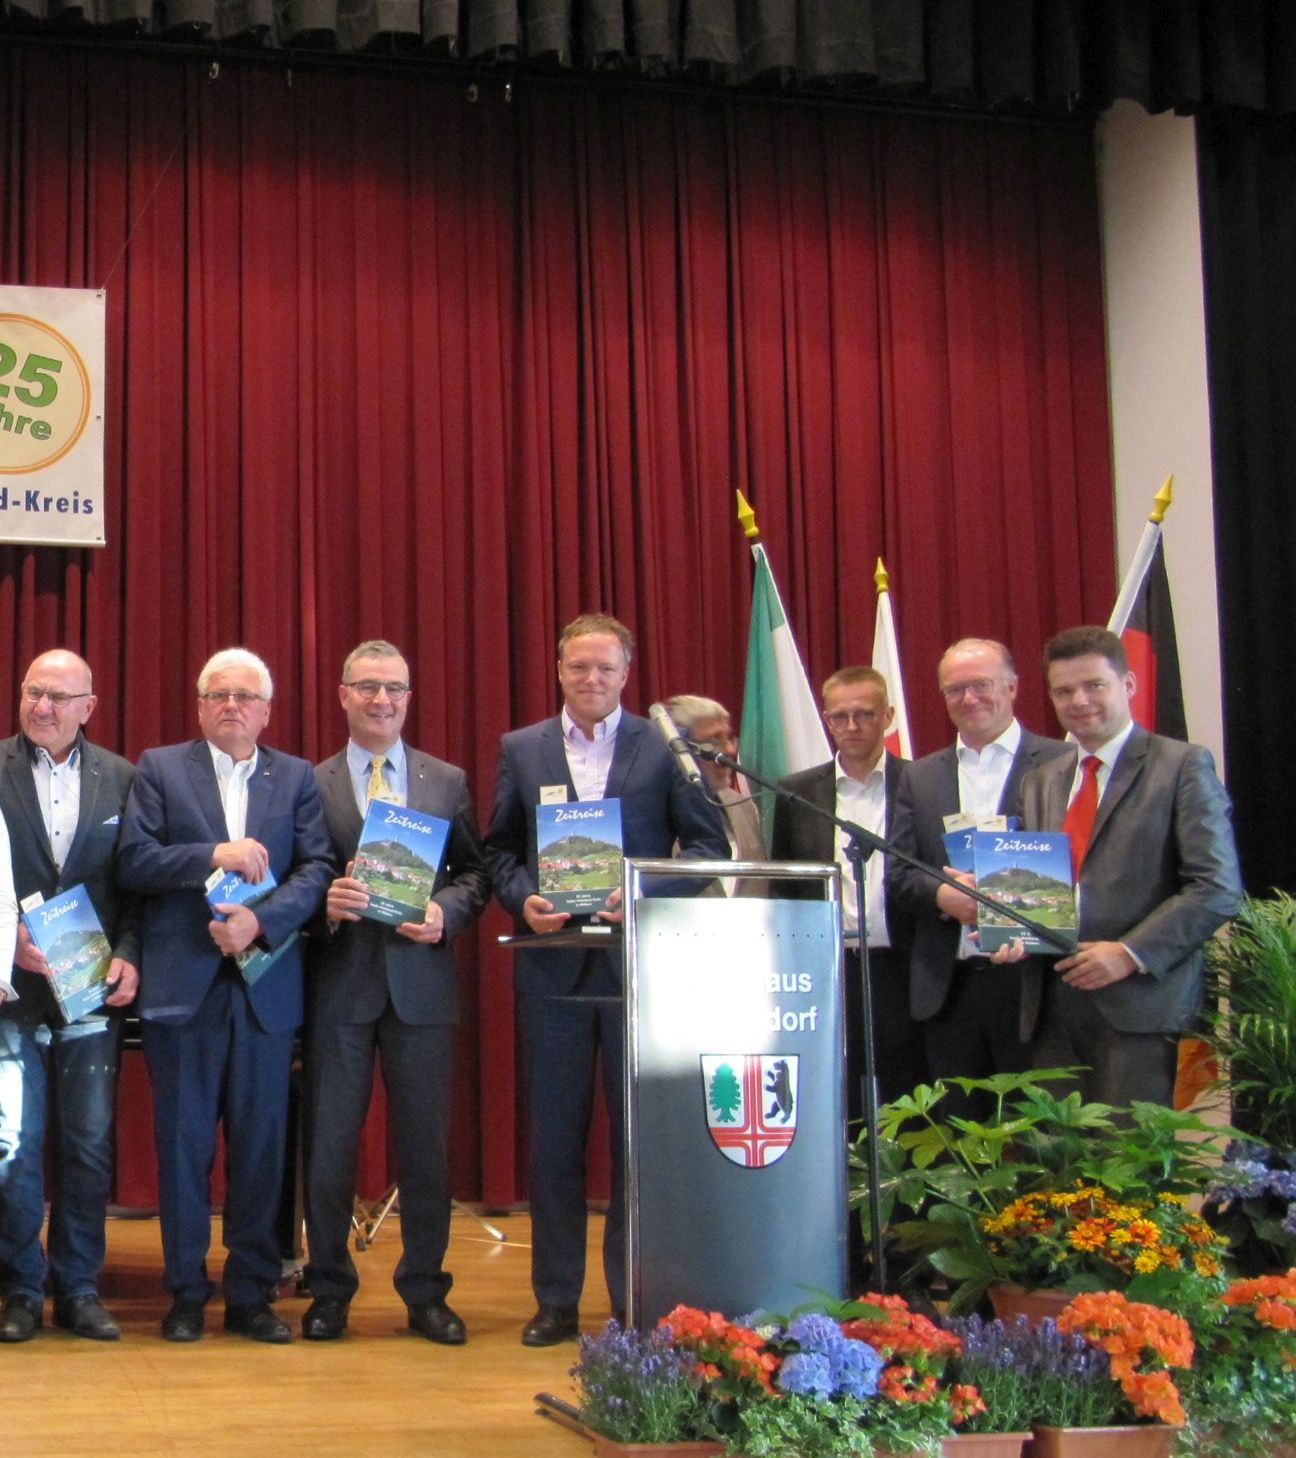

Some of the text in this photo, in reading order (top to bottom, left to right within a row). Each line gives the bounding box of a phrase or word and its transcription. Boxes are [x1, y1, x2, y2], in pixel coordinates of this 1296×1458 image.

[384, 810, 433, 834] Zeitreise
[554, 808, 605, 823] Zeitreise
[994, 838, 1052, 852] Zeitreise
[40, 899, 79, 925] Zeitreise
[766, 972, 813, 993] aus
[768, 1005, 818, 1032] dorf
